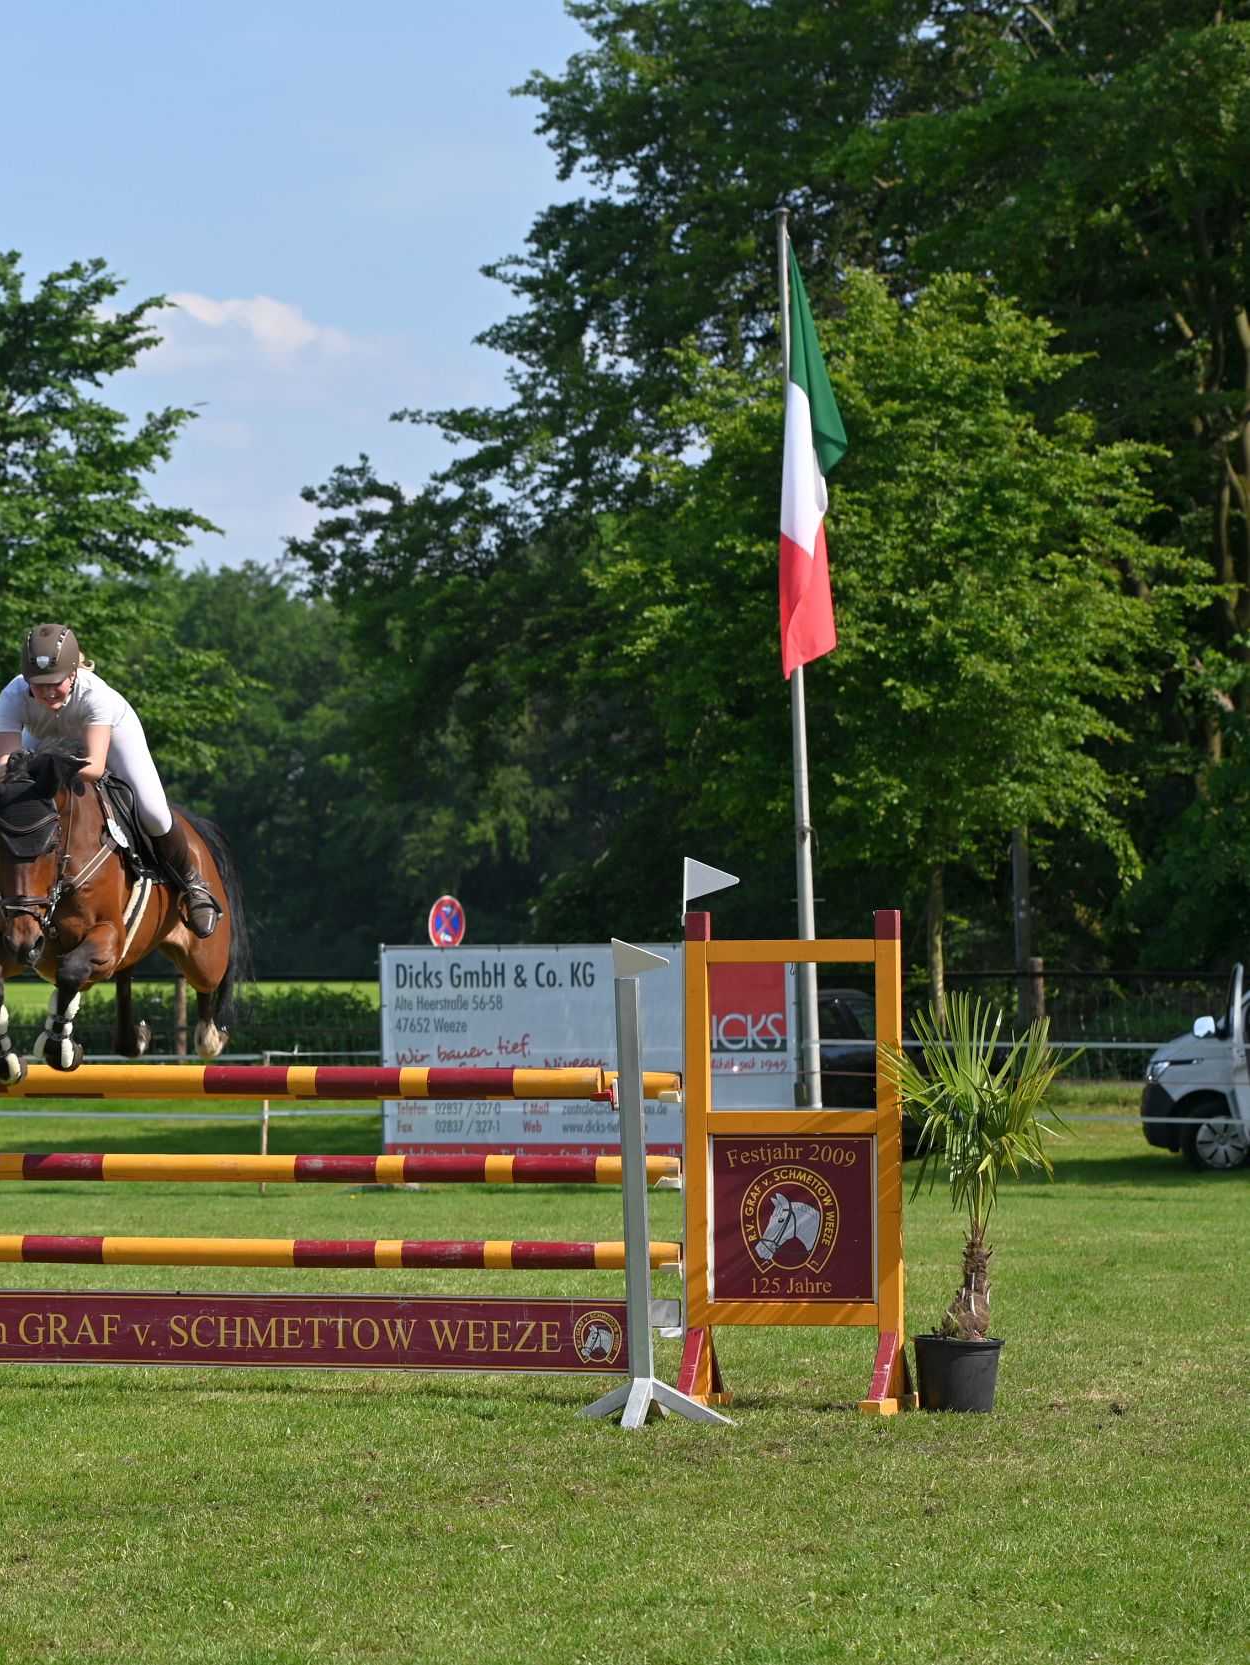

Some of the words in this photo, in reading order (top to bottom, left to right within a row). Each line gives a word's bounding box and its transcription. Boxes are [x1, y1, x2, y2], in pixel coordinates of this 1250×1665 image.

[395, 961, 443, 989] Dicks
[450, 960, 505, 989] GmbH
[513, 963, 527, 988] &
[535, 961, 563, 988] Co.
[570, 961, 595, 988] KG
[395, 995, 413, 1011] Alte
[416, 994, 469, 1011] Heerstraße
[472, 996, 503, 1011] 56-58
[396, 1018, 430, 1034] 47652
[433, 1018, 468, 1034] Weeze
[396, 1048, 431, 1066] Wir
[438, 1044, 493, 1062] bauen
[397, 1121, 414, 1133] Fax
[523, 1120, 542, 1133] Web
[726, 1142, 804, 1168] Festjahr
[808, 1143, 857, 1168] 2009
[744, 1184, 763, 1218] GRAF
[773, 1169, 834, 1207] SCHMETTOW
[821, 1210, 836, 1247] WEEZE
[751, 1277, 781, 1294] 125
[786, 1276, 832, 1295] Jahre
[18, 1312, 121, 1346] GRAF
[133, 1323, 157, 1347] v.
[169, 1314, 418, 1351] SCHMETTOW
[428, 1318, 564, 1354] WEEZE
